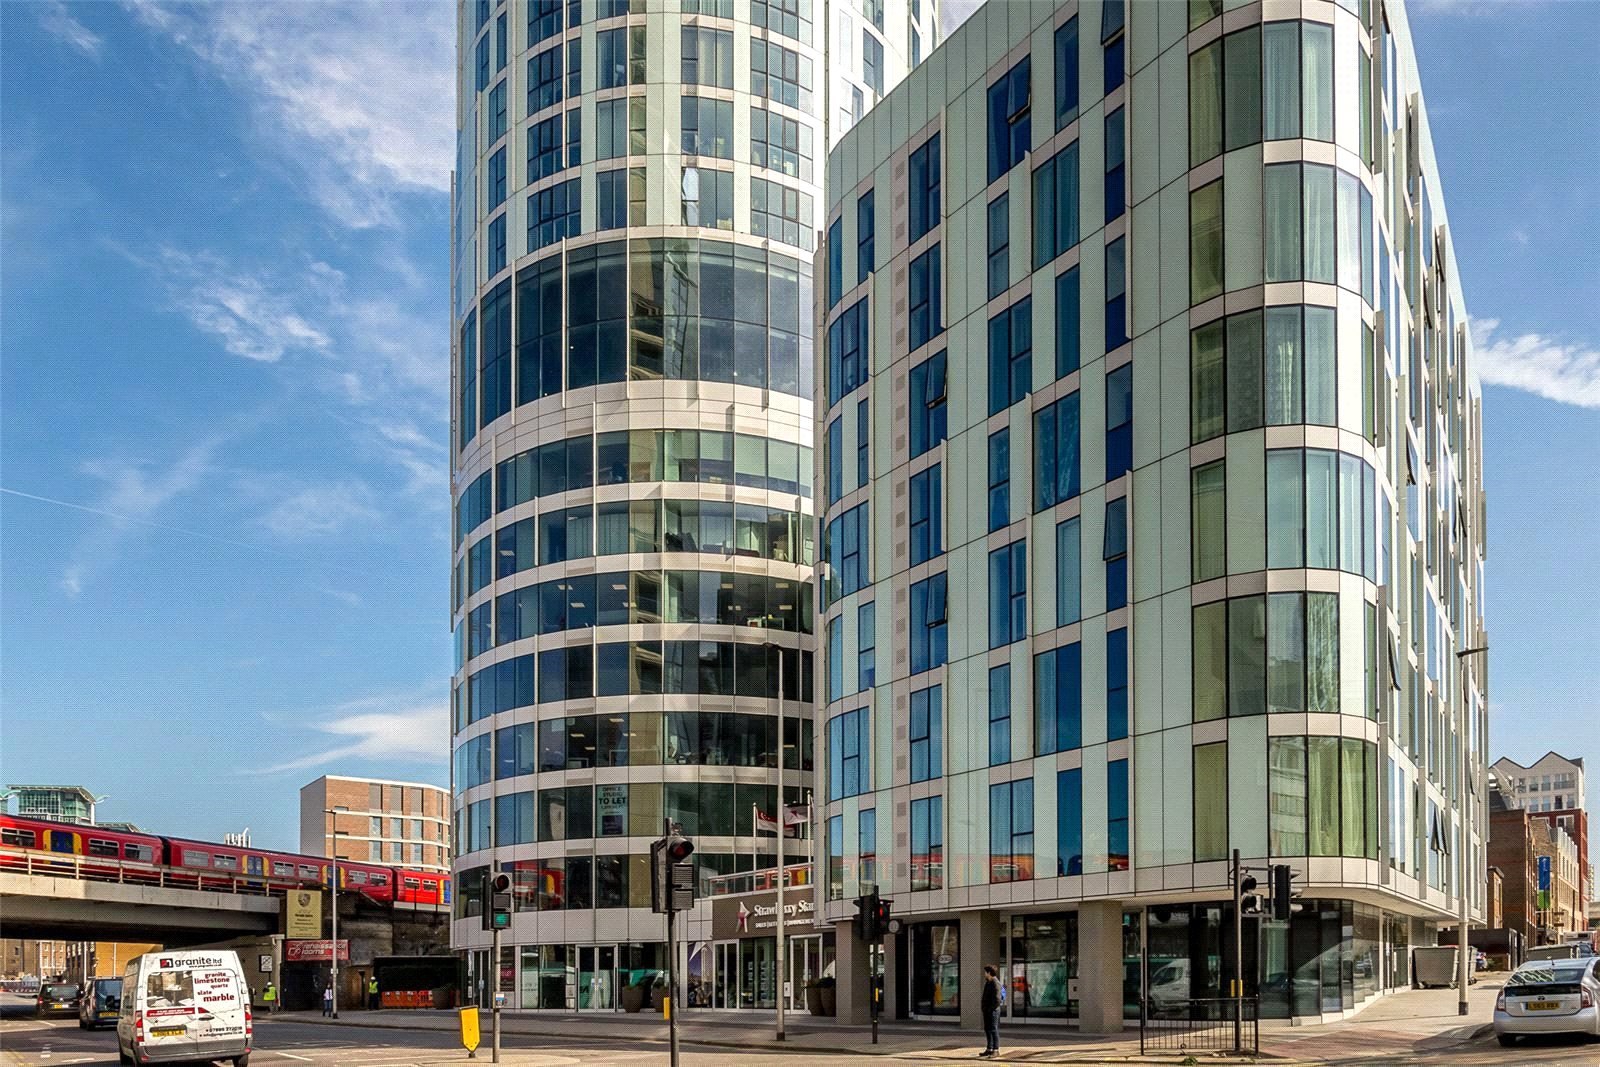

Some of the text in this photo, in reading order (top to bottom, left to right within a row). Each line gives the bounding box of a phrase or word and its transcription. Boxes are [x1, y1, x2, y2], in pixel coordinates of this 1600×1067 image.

[599, 797, 610, 805] TO
[754, 902, 798, 917] Strawrry
[174, 957, 212, 967] granite
[205, 971, 226, 979] granite
[203, 993, 235, 1002] marble
